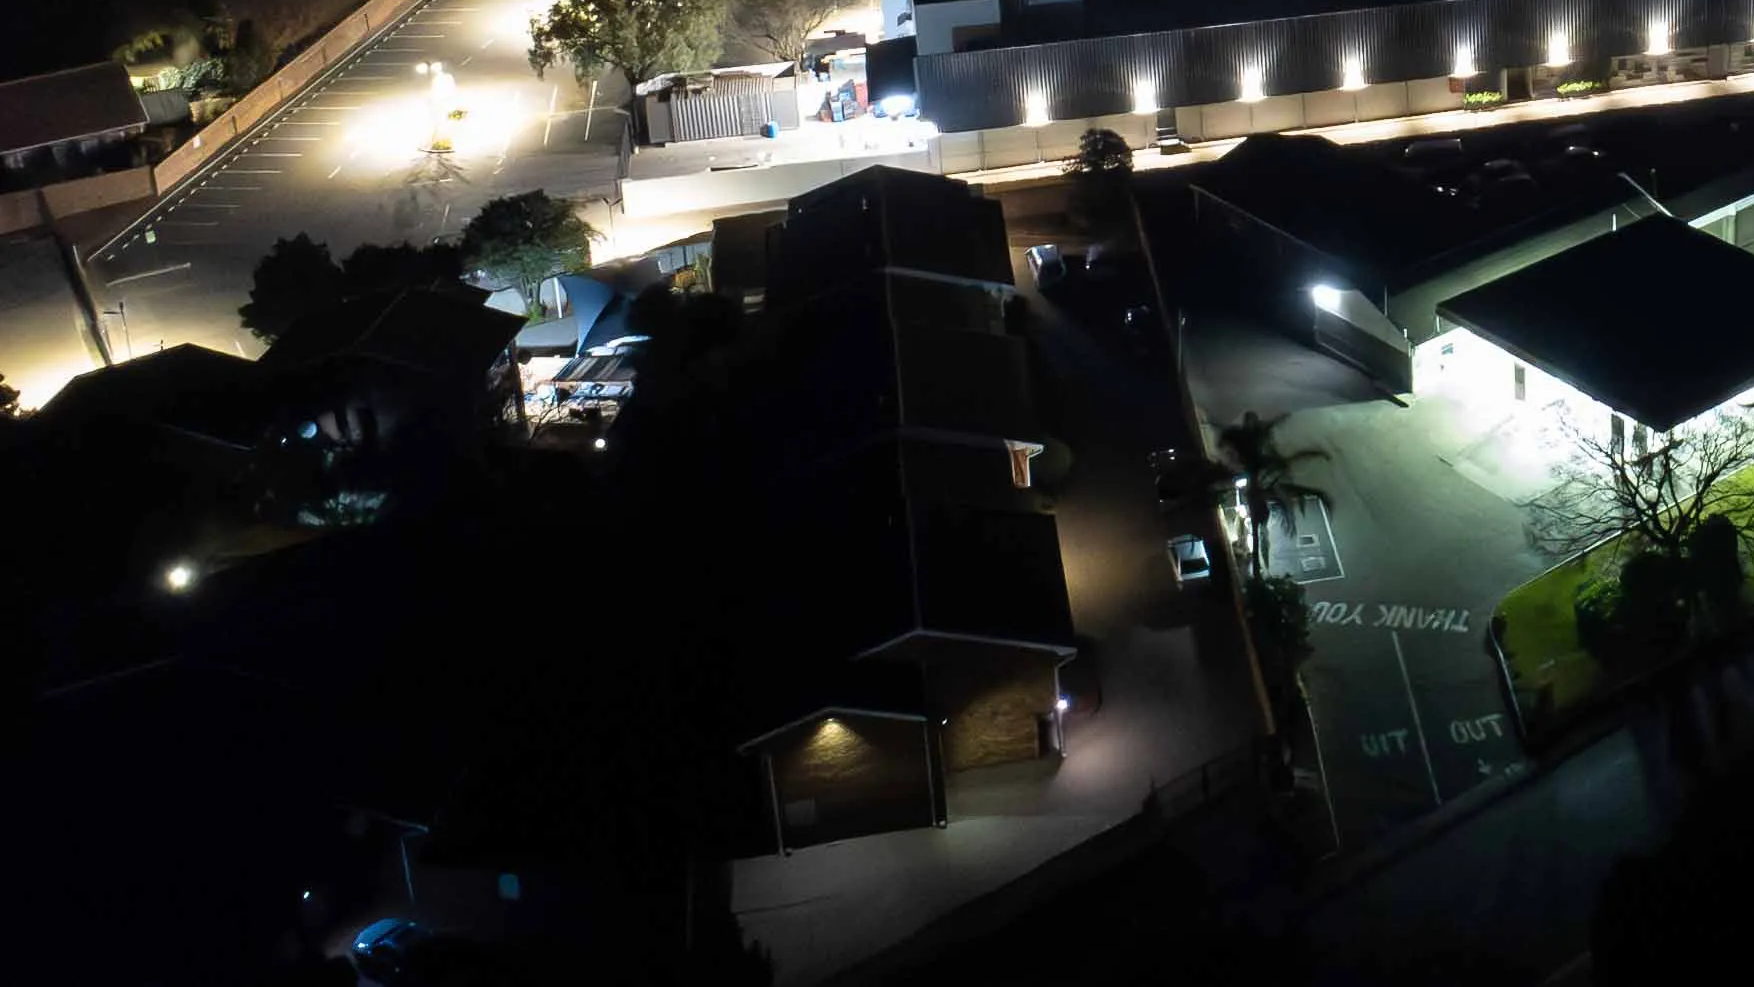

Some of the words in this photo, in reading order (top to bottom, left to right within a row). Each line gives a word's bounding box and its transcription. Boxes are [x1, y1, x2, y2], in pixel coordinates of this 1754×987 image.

[1311, 601, 1364, 625] YOU
[1373, 604, 1470, 632] THANK
[1360, 728, 1408, 757] UIT
[1450, 713, 1504, 744] OUT
